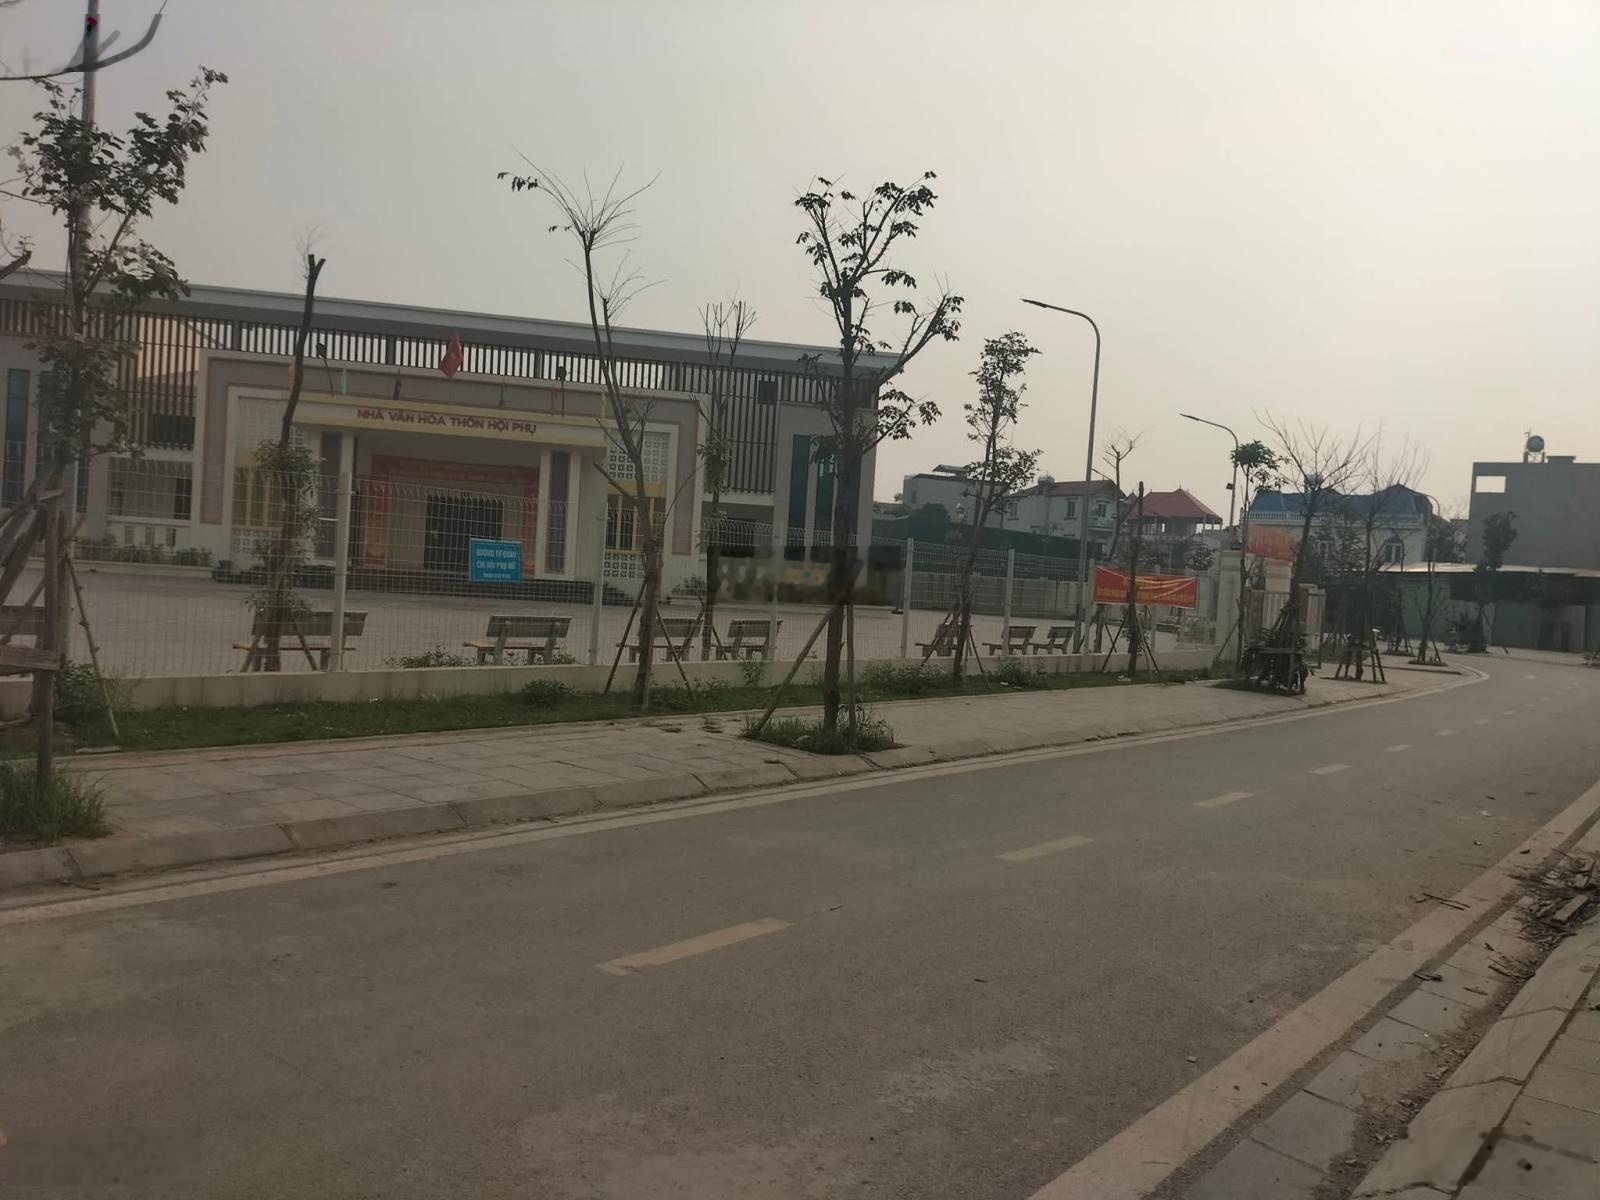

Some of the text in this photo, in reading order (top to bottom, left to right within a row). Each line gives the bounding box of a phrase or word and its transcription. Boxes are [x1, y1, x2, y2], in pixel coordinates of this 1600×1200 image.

[357, 407, 537, 436] NHÀ VĂN HÓA THÔN HỘI PHỤ
